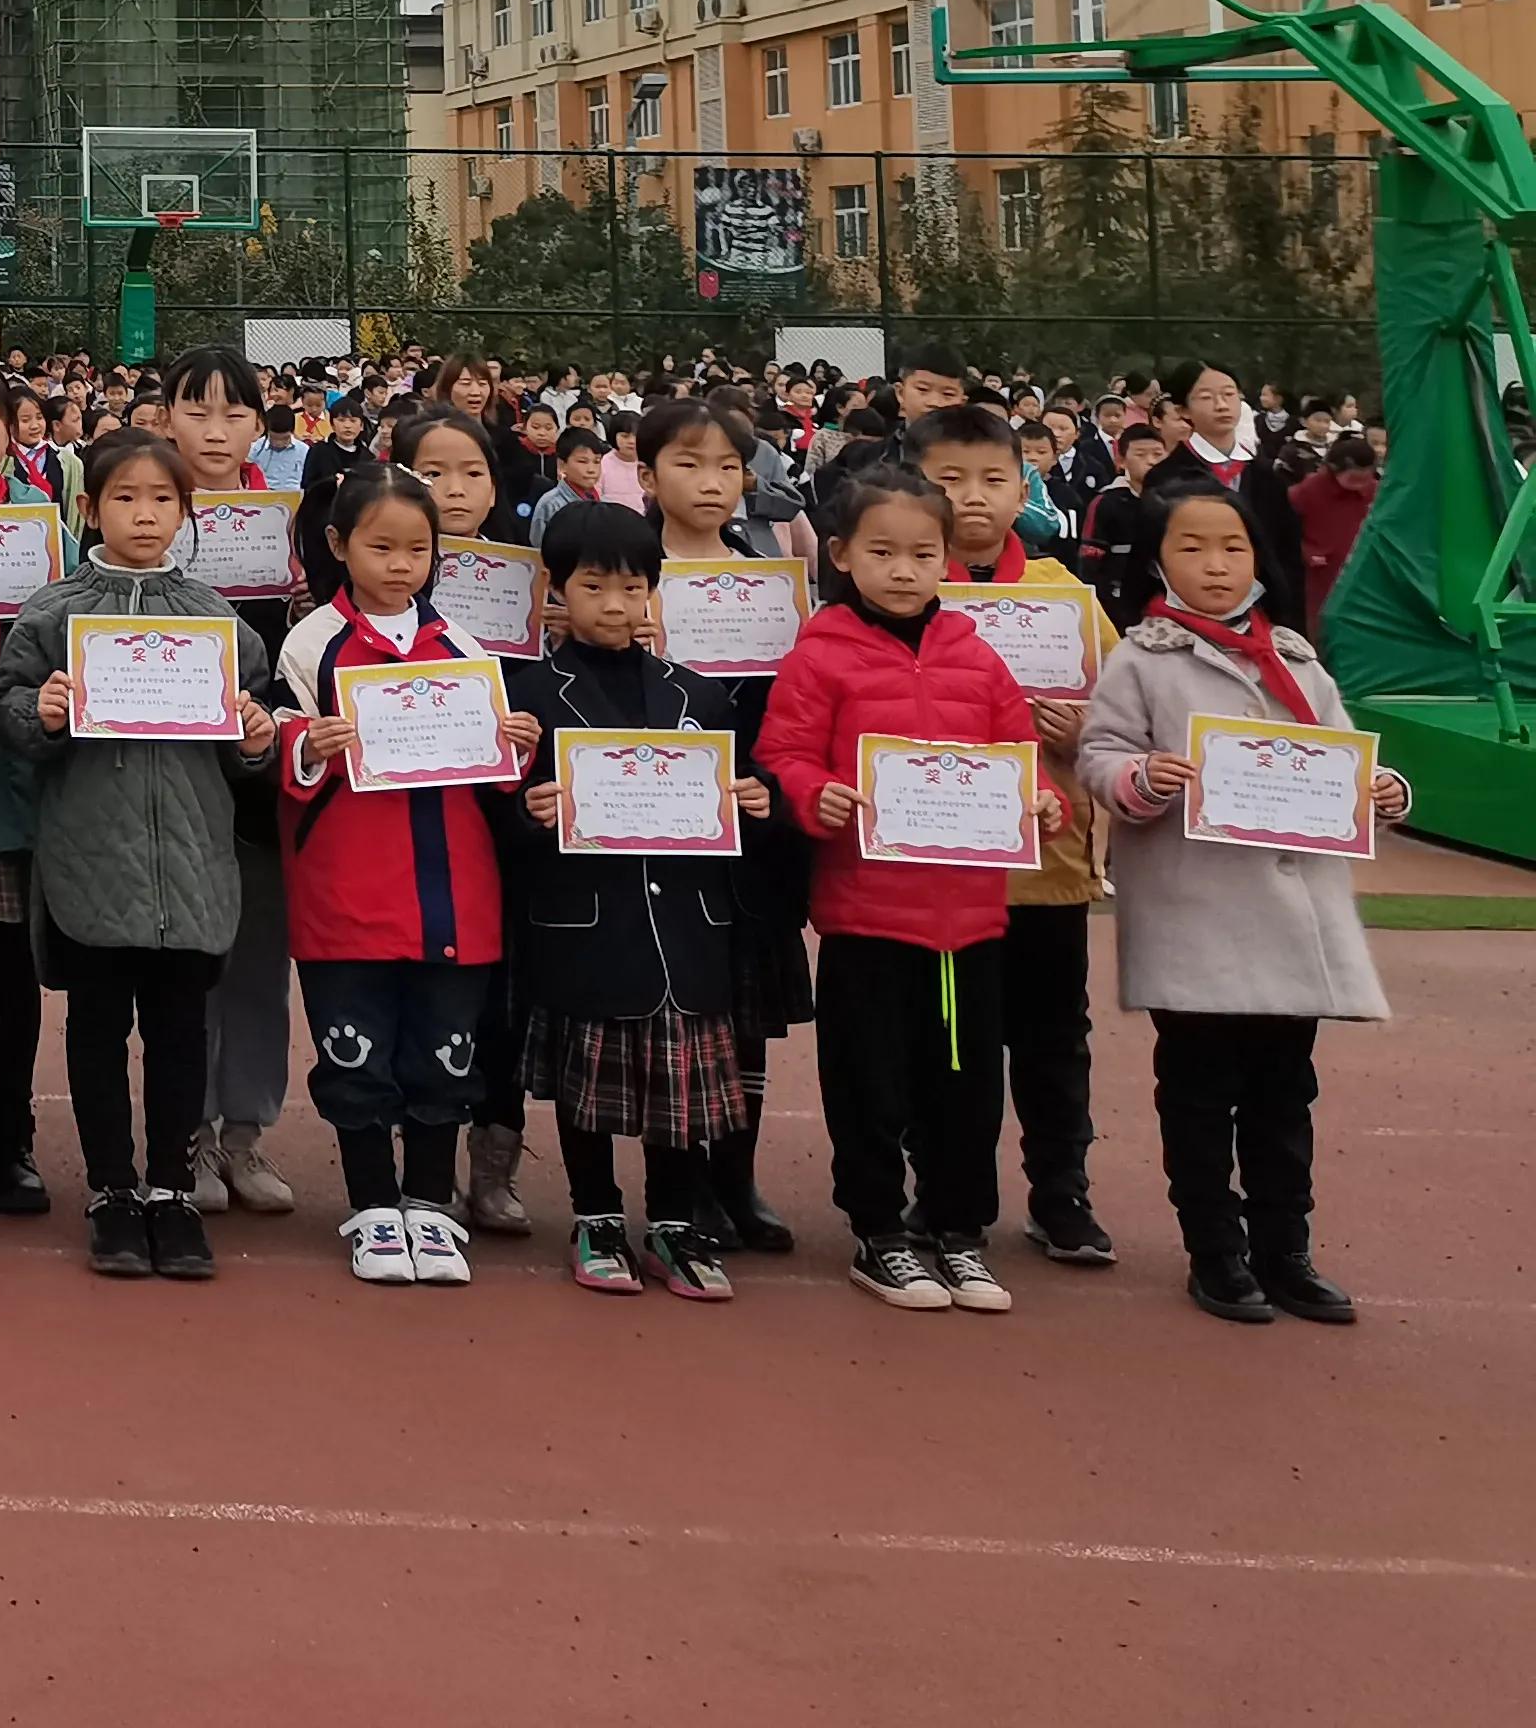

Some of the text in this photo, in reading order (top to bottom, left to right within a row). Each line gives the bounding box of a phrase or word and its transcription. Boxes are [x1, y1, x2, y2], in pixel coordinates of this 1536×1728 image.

[204, 519, 246, 533] 奖状
[442, 566, 489, 581] 奖状
[708, 588, 752, 603] 奖状
[132, 648, 177, 663] 奖状
[402, 694, 447, 710] 奖状
[622, 762, 669, 777] 奖状
[1258, 754, 1307, 773] 奖状
[926, 770, 973, 785] 奖状
